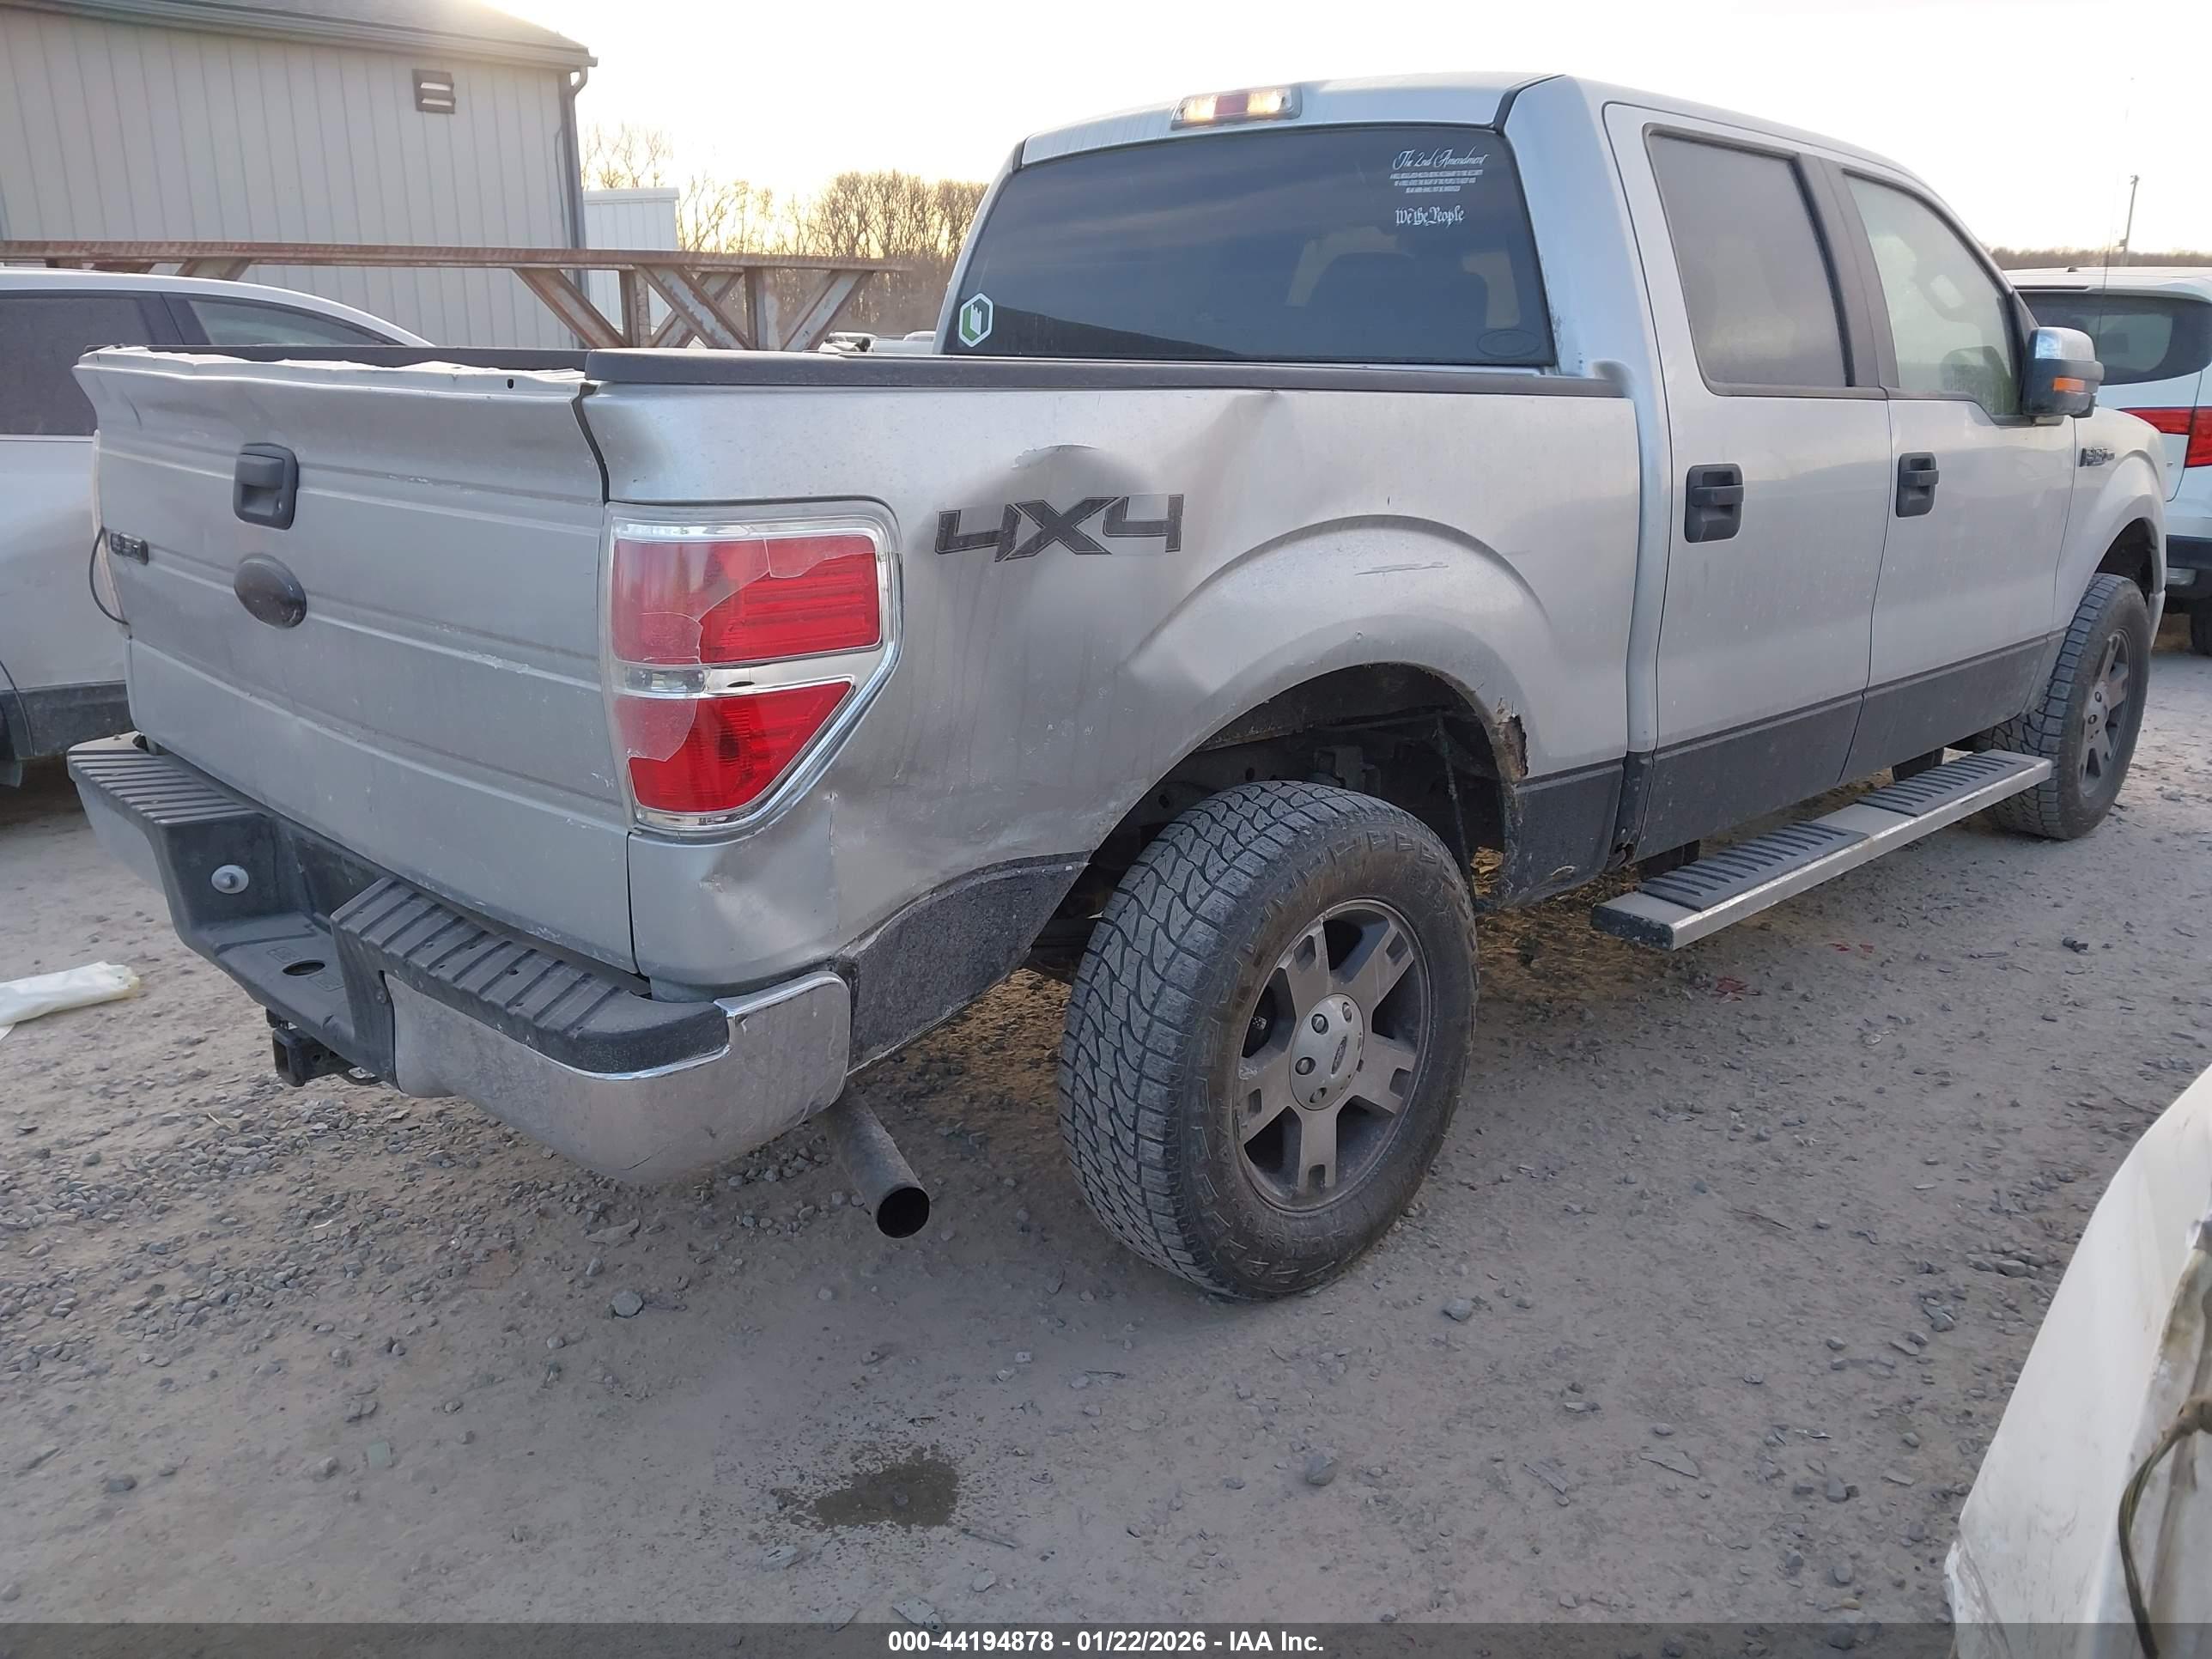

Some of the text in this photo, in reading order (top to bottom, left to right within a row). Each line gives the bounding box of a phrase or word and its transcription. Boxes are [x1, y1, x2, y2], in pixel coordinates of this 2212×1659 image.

[1393, 145, 1490, 170] The 2nd Amendment
[1395, 204, 1464, 228] We the People
